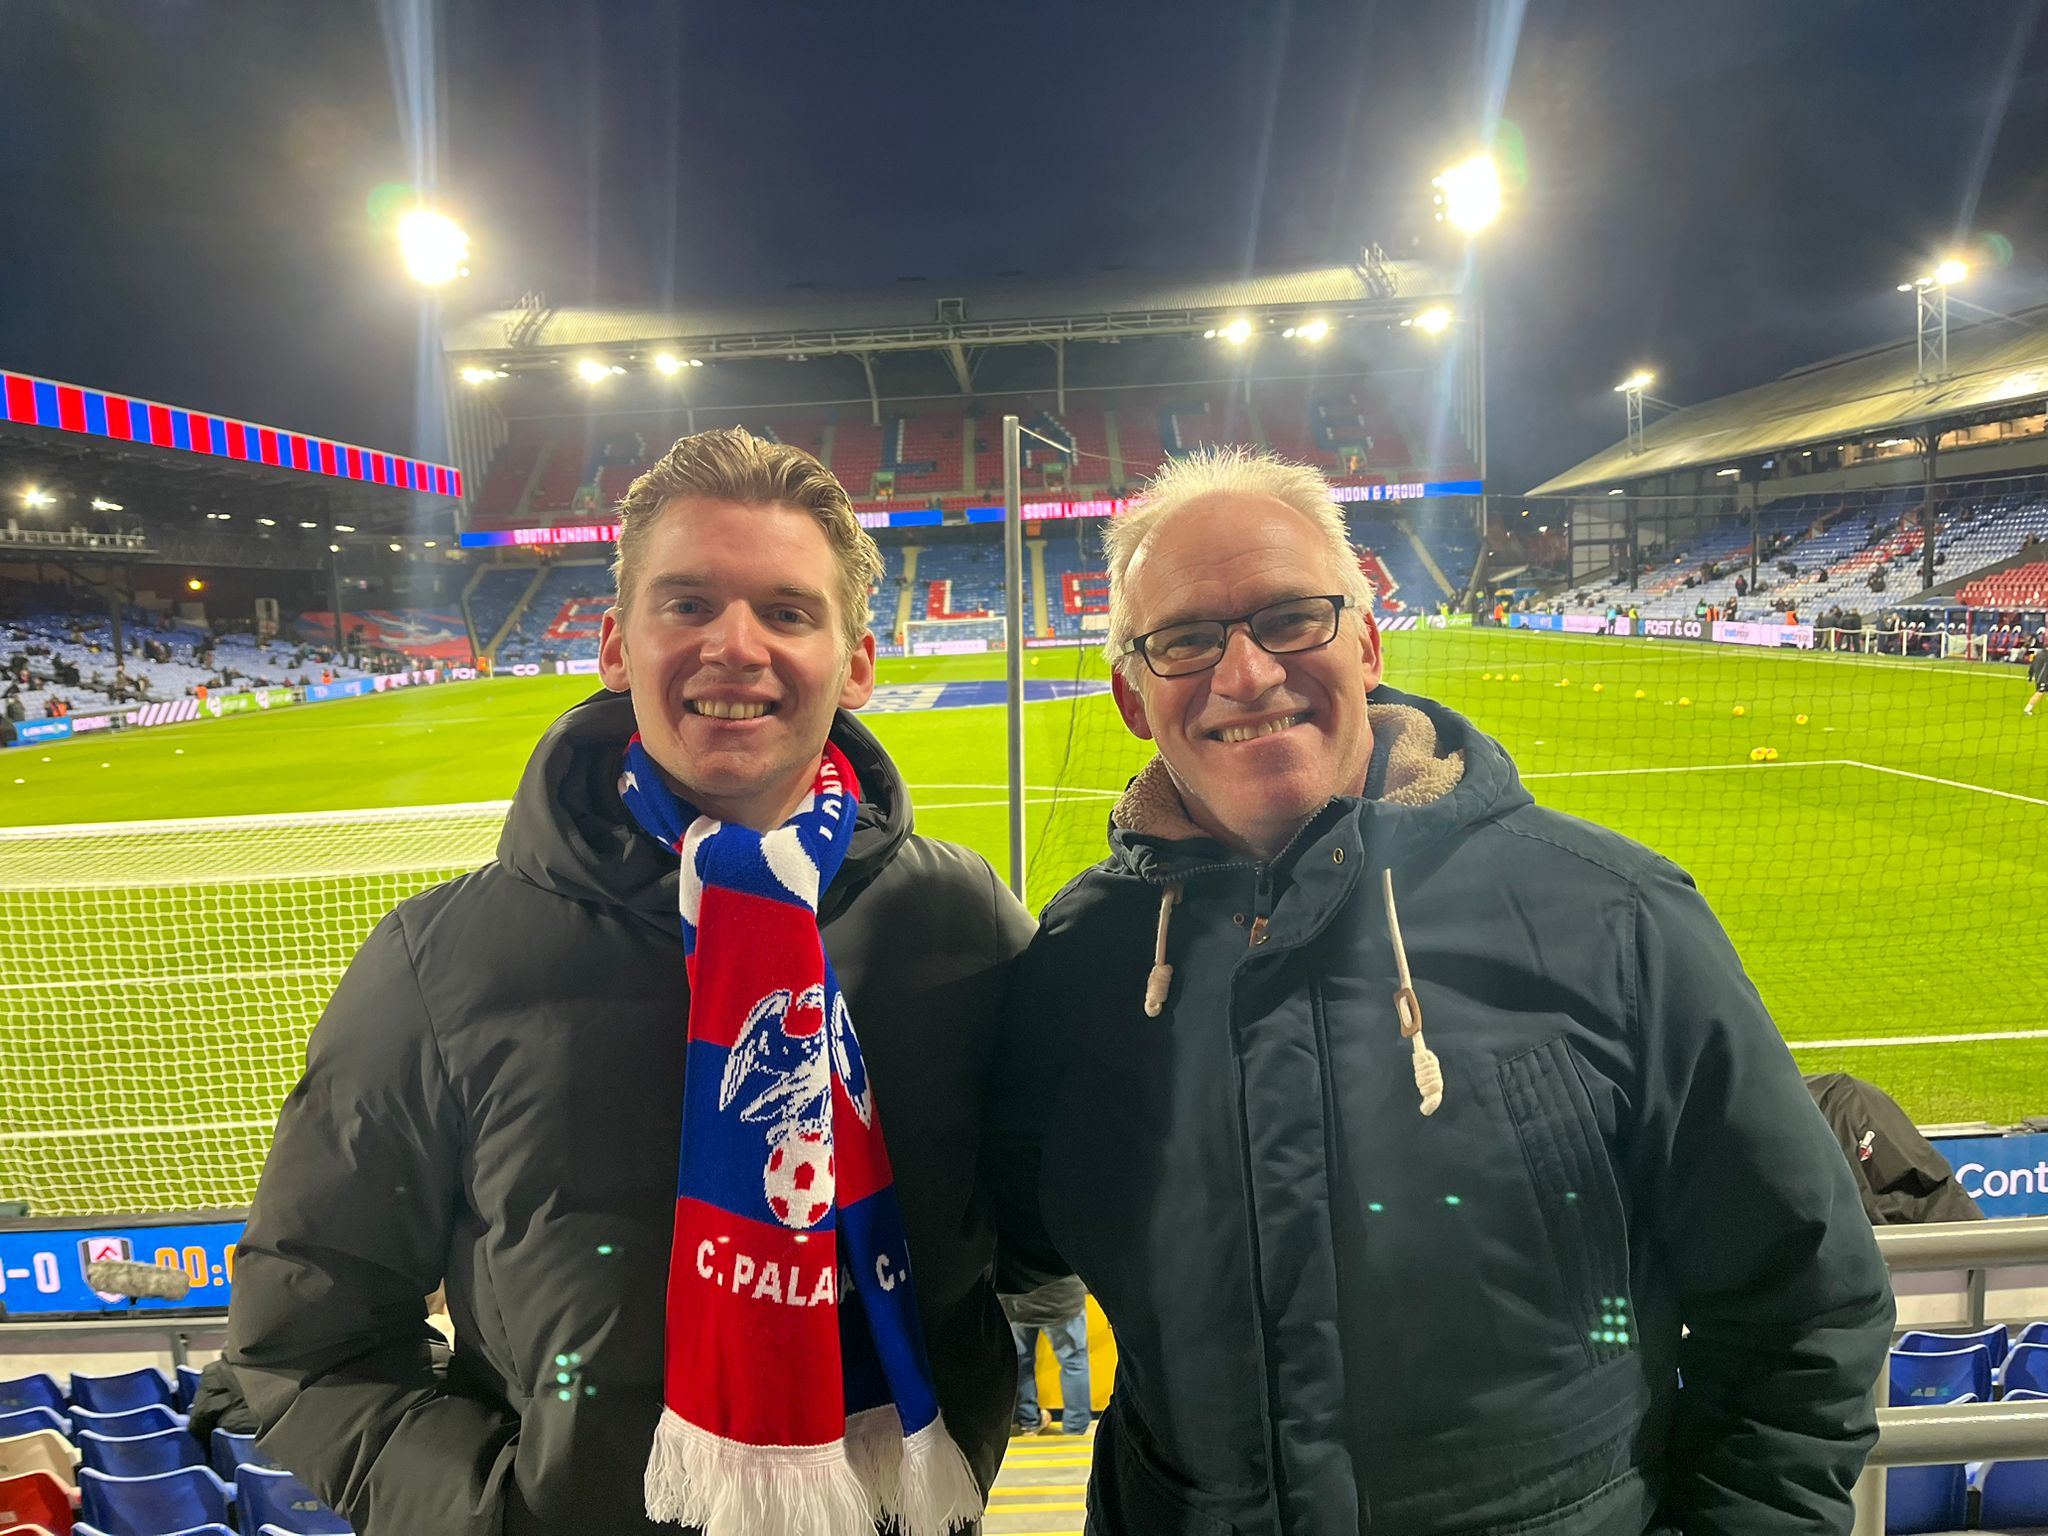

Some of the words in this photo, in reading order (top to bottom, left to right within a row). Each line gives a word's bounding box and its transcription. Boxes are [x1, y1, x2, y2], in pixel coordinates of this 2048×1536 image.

[1385, 483, 1424, 500] PROUD
[1023, 502, 1061, 519] SOUTH
[1064, 500, 1111, 517] LONDON
[514, 528, 550, 544] SOUTH
[553, 526, 598, 543] LONDON
[1675, 619, 1682, 636] &
[1684, 621, 1701, 637] CO
[1955, 1161, 2048, 1198] Cont
